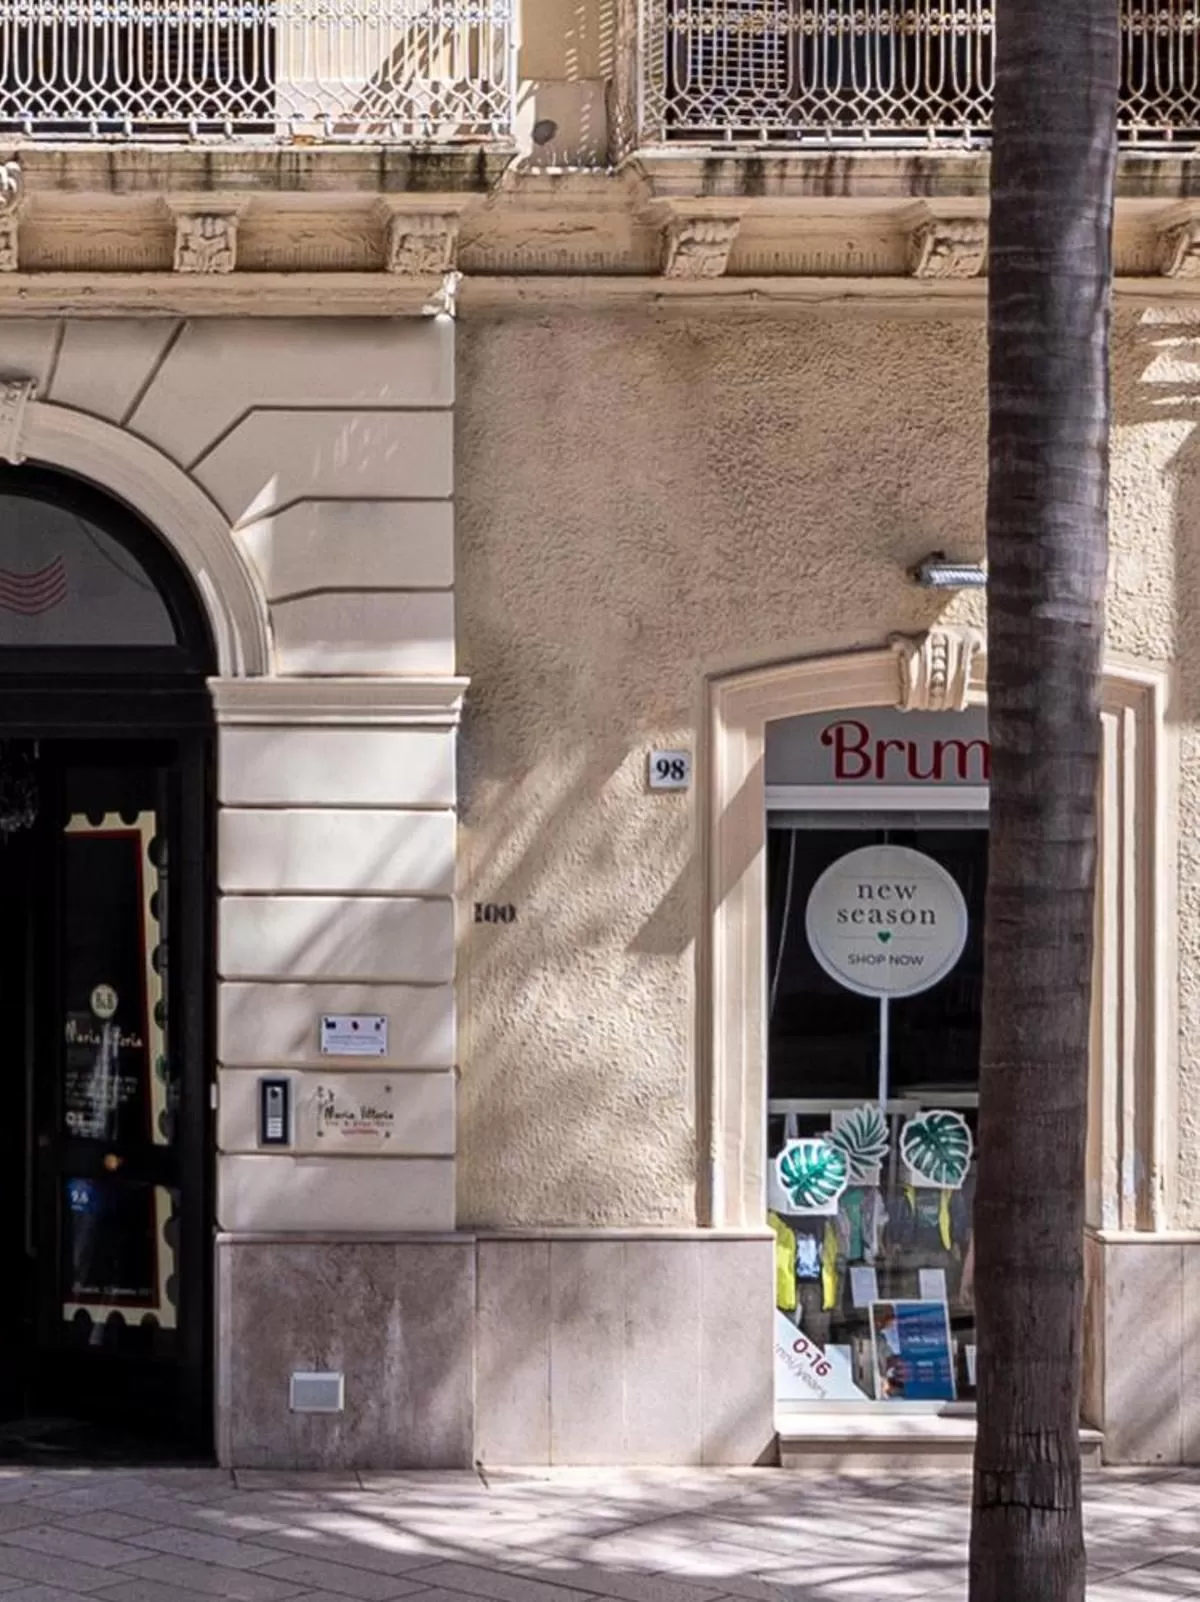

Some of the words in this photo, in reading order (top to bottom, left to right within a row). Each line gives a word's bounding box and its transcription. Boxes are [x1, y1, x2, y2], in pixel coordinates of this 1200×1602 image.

[820, 720, 992, 780] Brum
[656, 758, 685, 781] 98
[857, 883, 917, 900] new
[474, 902, 516, 924] 100
[837, 908, 936, 925] season
[847, 953, 886, 965] SHOP
[889, 953, 924, 966] NOW
